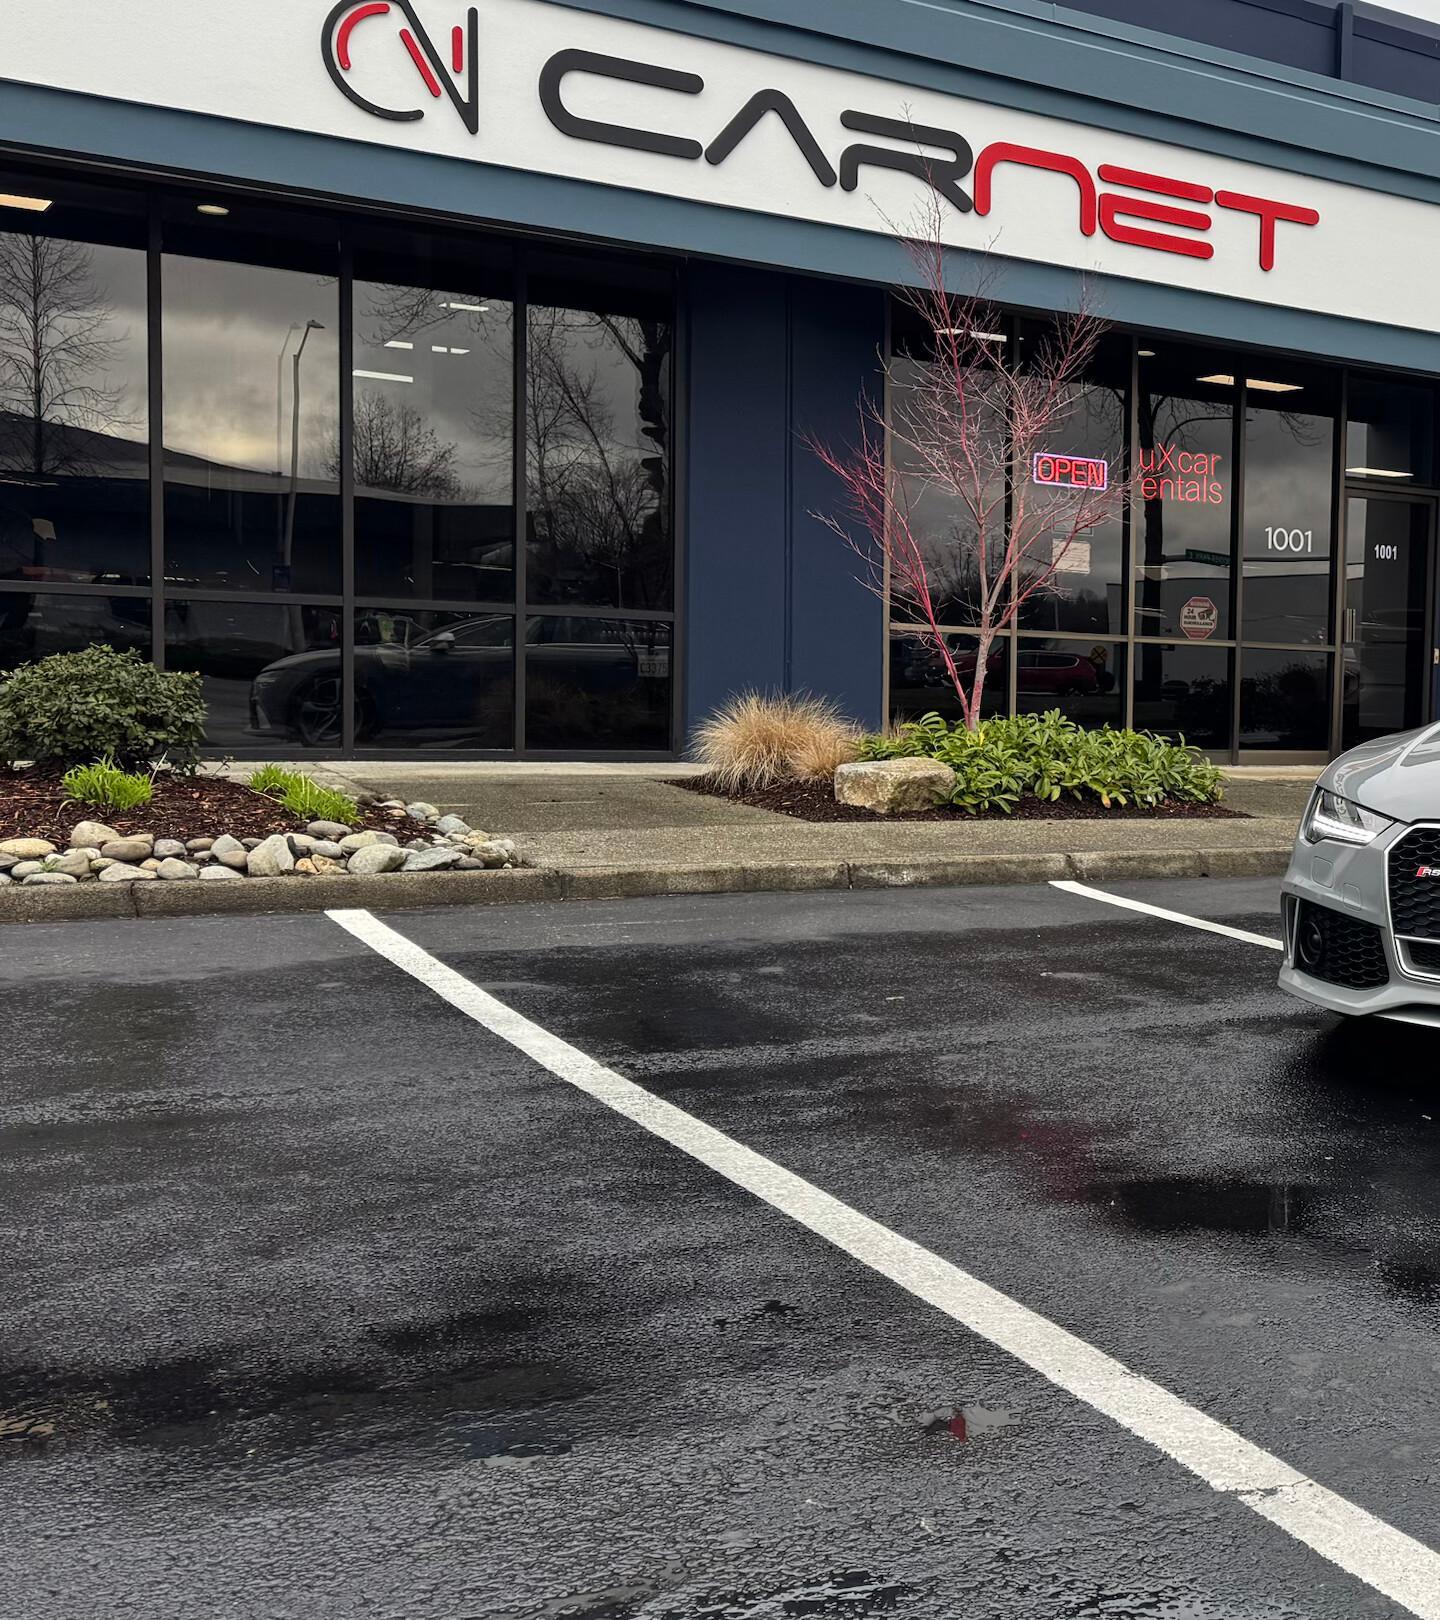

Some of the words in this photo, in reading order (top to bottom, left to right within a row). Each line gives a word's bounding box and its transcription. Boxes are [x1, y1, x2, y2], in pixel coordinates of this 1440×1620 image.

[538, 47, 1320, 273] CARNET
[1037, 455, 1105, 488] OPEN
[1139, 442, 1221, 476] uXcar
[1141, 474, 1223, 504] entals
[1265, 526, 1313, 553] 1001
[1374, 544, 1398, 560] 1001
